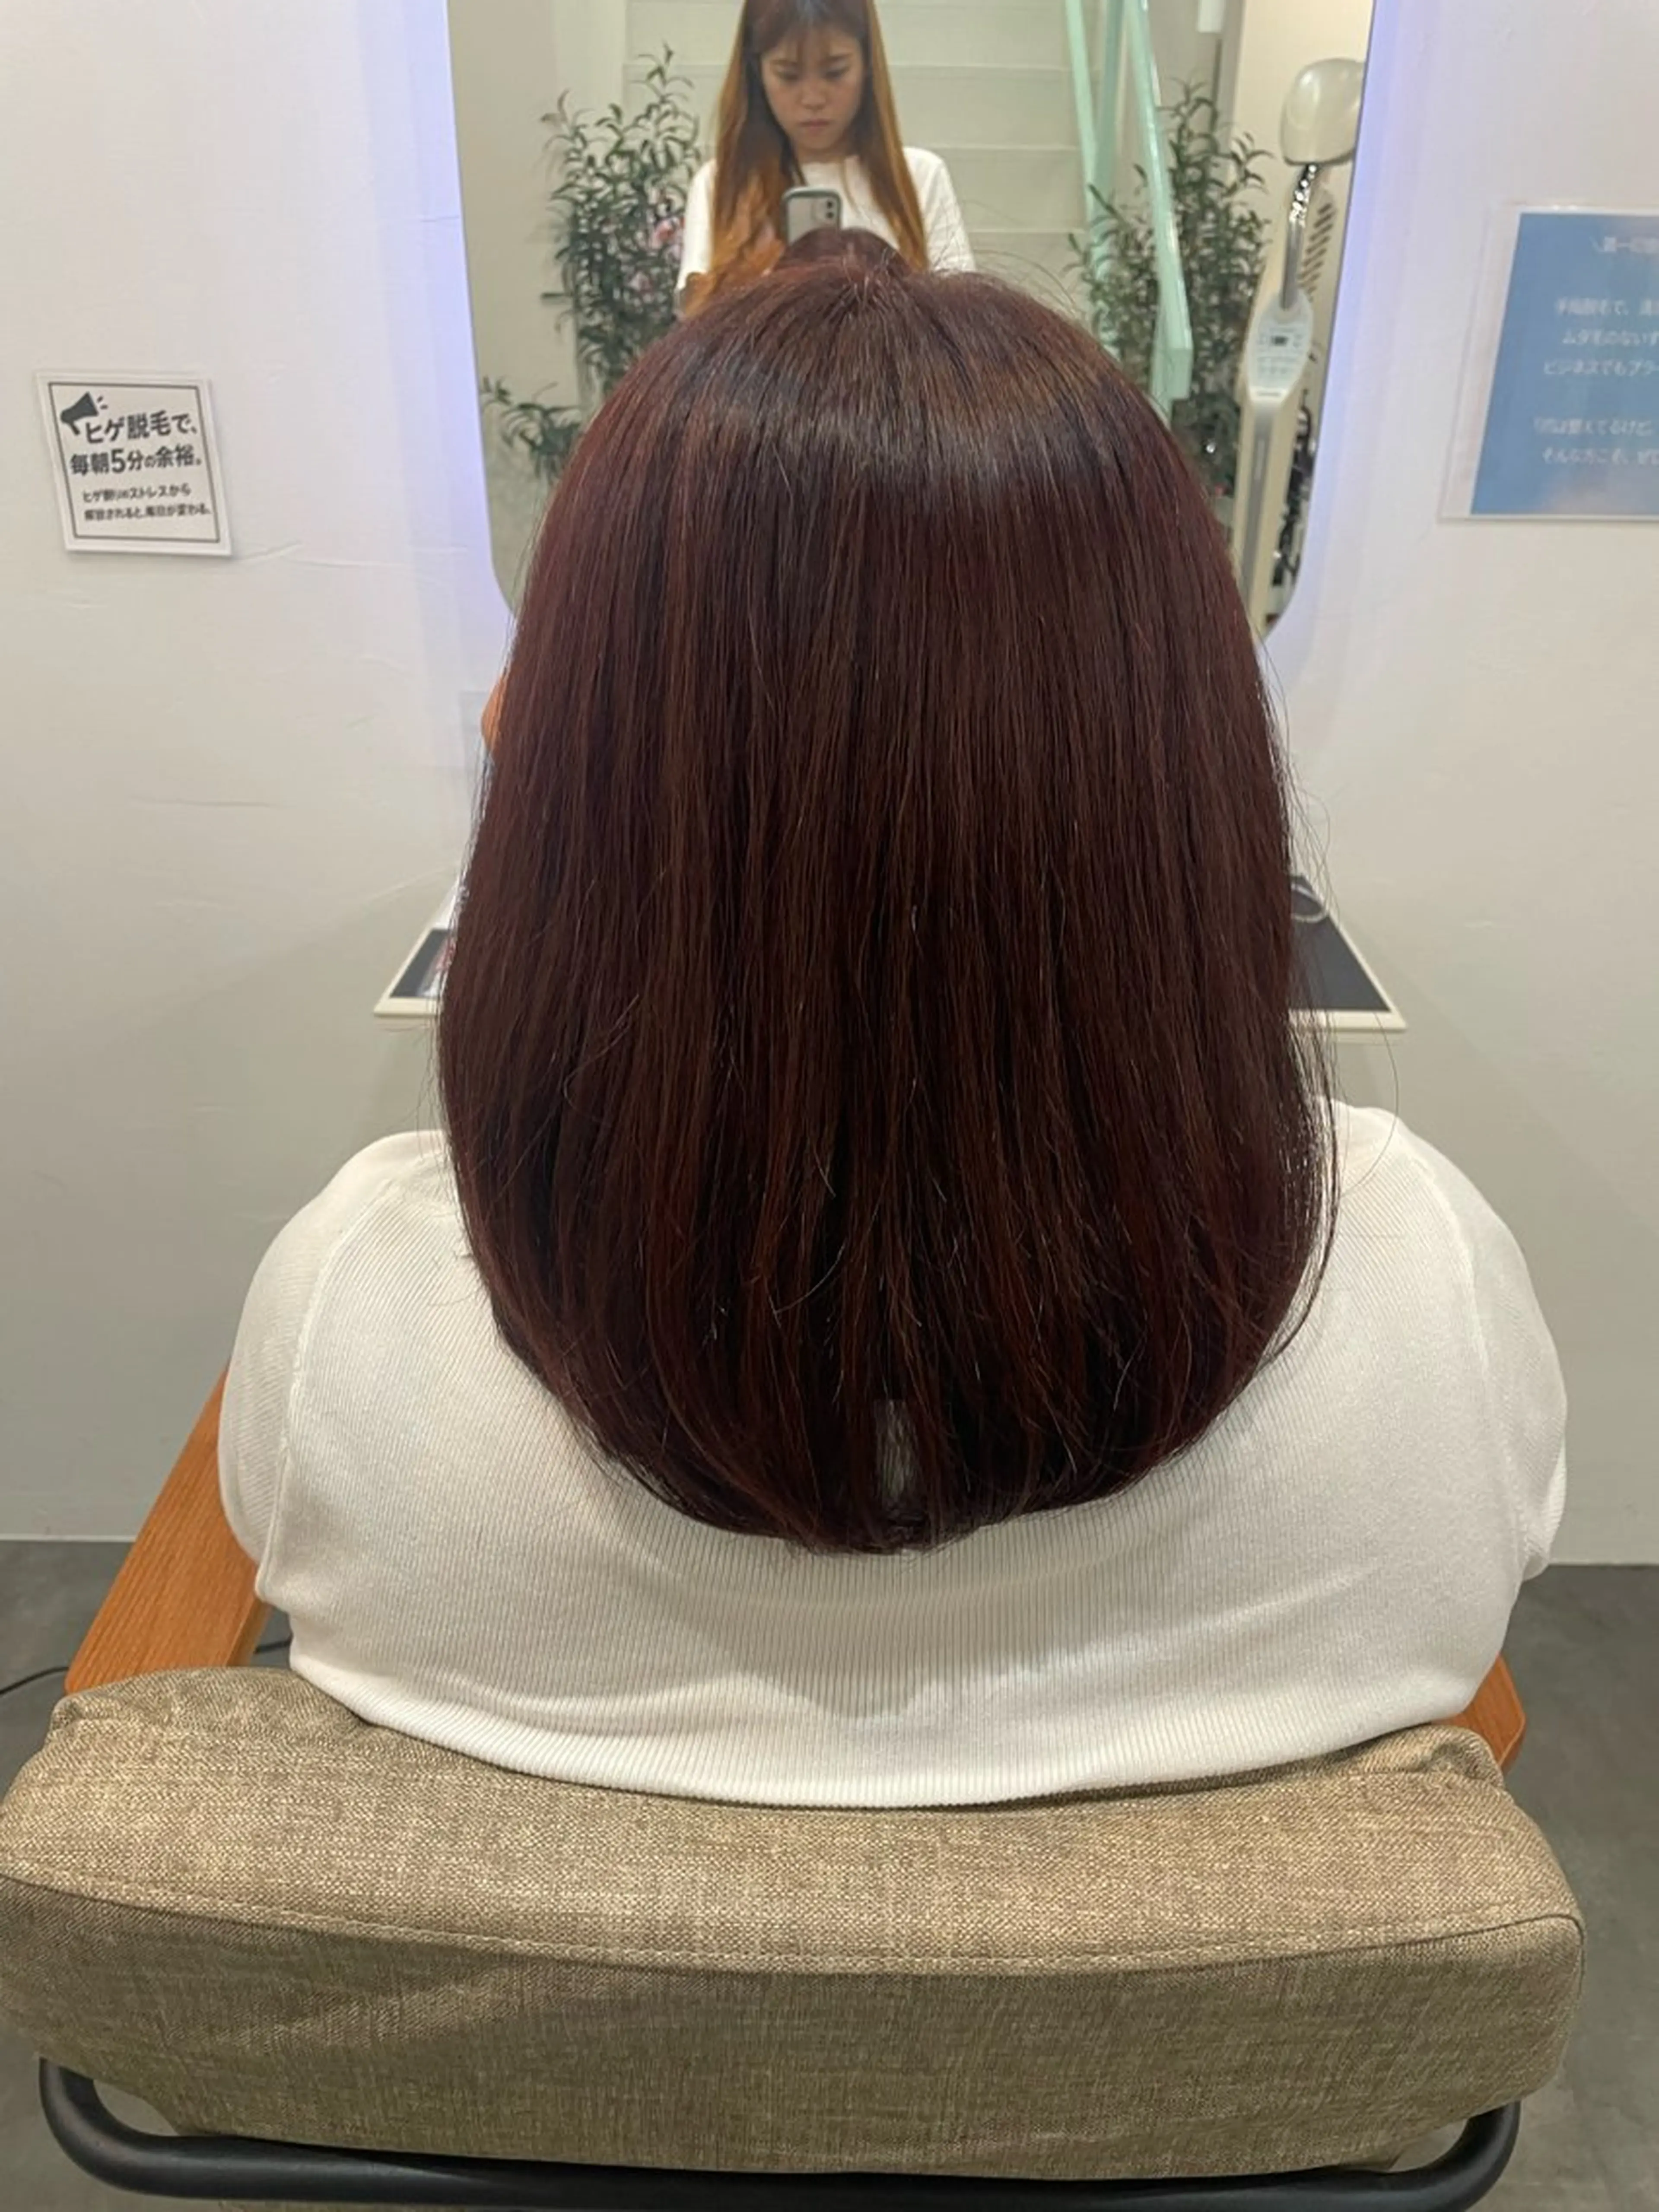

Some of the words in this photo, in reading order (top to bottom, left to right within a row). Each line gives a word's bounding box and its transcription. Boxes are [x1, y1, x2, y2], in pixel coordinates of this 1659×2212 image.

[86, 410, 197, 444] ヒゲ脱毛で、
[70, 444, 202, 476] 毎朝5分の余裕。
